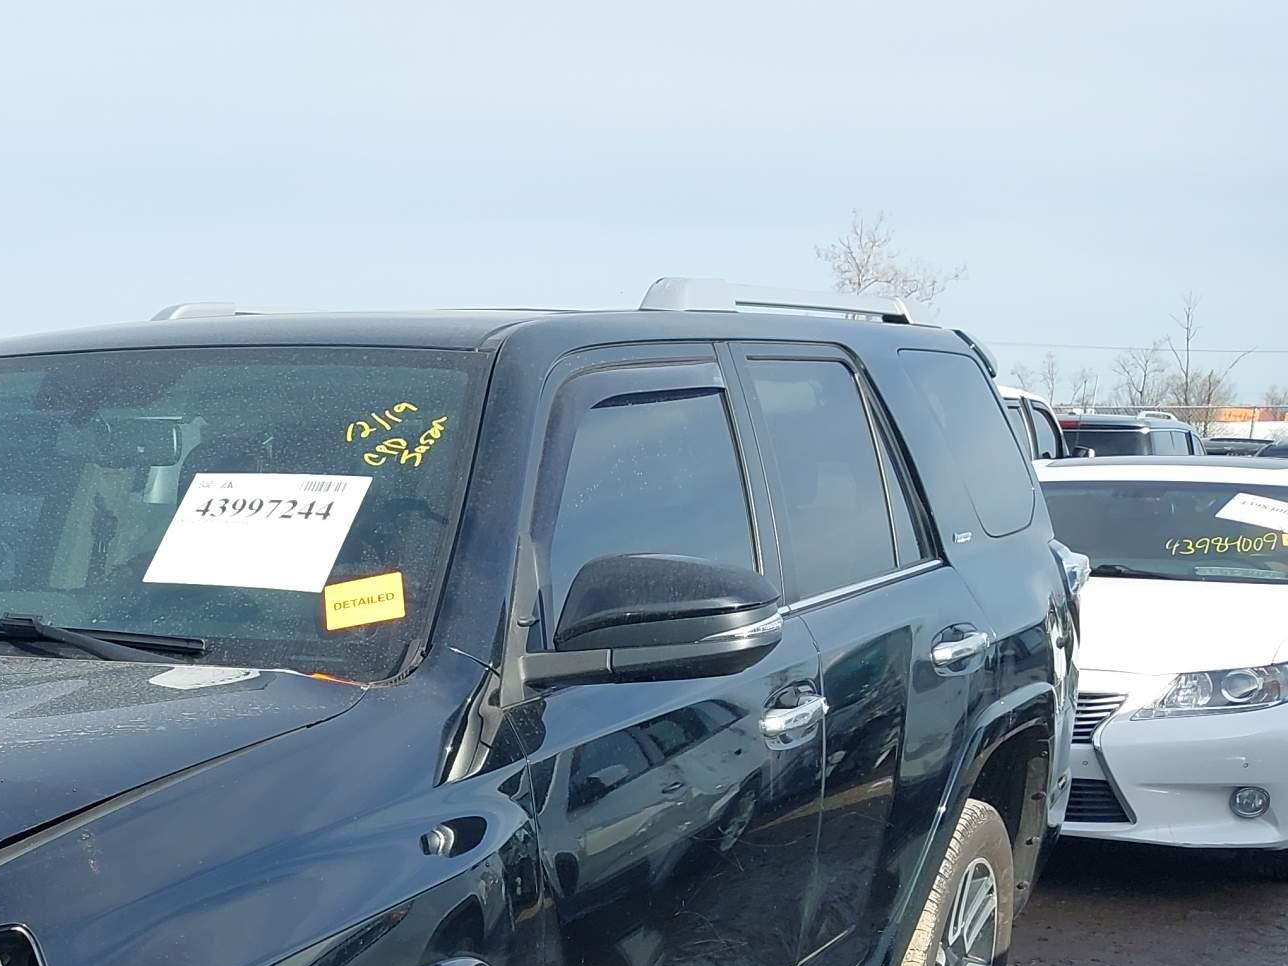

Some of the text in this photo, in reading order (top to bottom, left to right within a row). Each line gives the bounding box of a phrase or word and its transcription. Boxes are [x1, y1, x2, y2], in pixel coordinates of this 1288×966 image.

[195, 498, 335, 520] 43997244
[1165, 532, 1278, 556] 43984009
[333, 592, 395, 611] DETAILED
